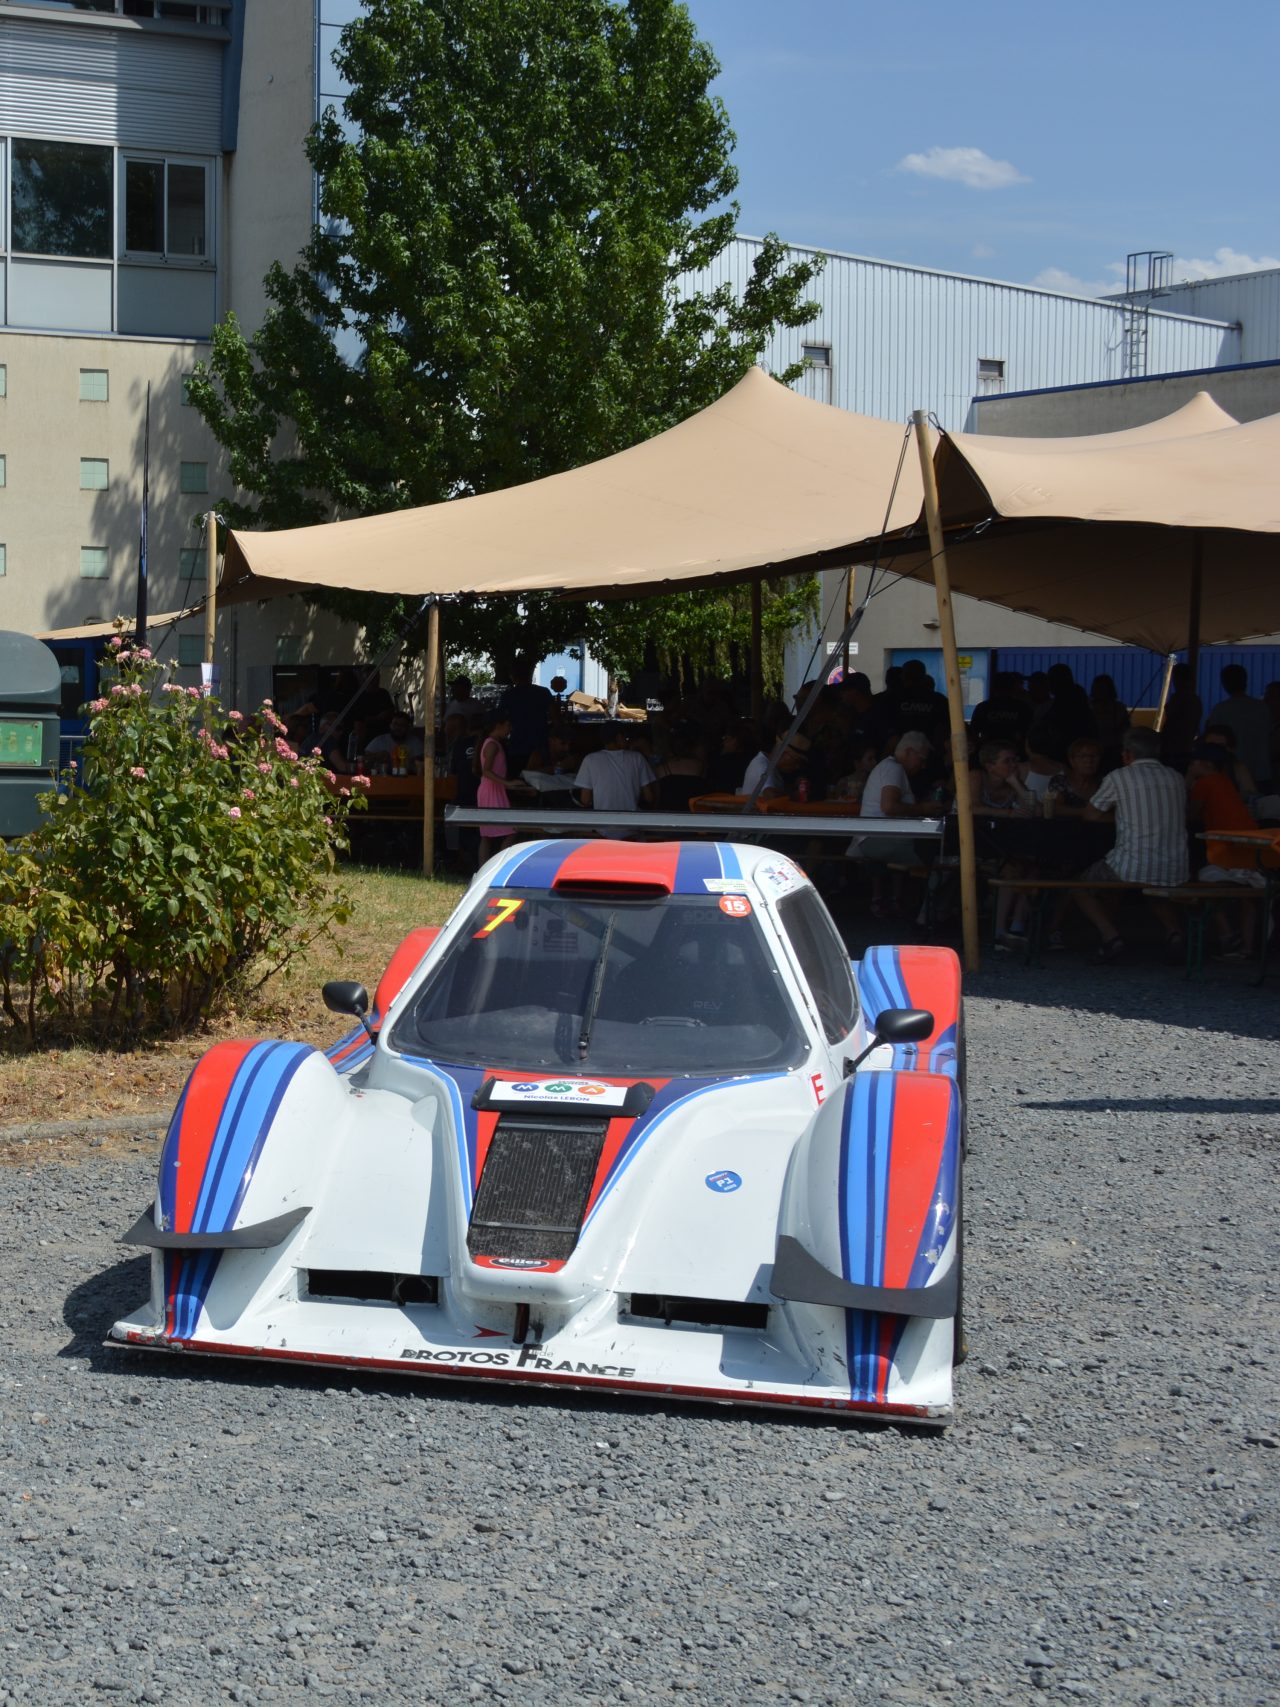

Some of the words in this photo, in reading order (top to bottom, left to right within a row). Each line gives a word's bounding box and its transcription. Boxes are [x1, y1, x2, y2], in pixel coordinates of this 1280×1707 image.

[472, 898, 525, 939] 7
[723, 900, 747, 912] 15
[400, 1348, 510, 1366] PROTOS
[516, 1343, 636, 1378] FRANCE
